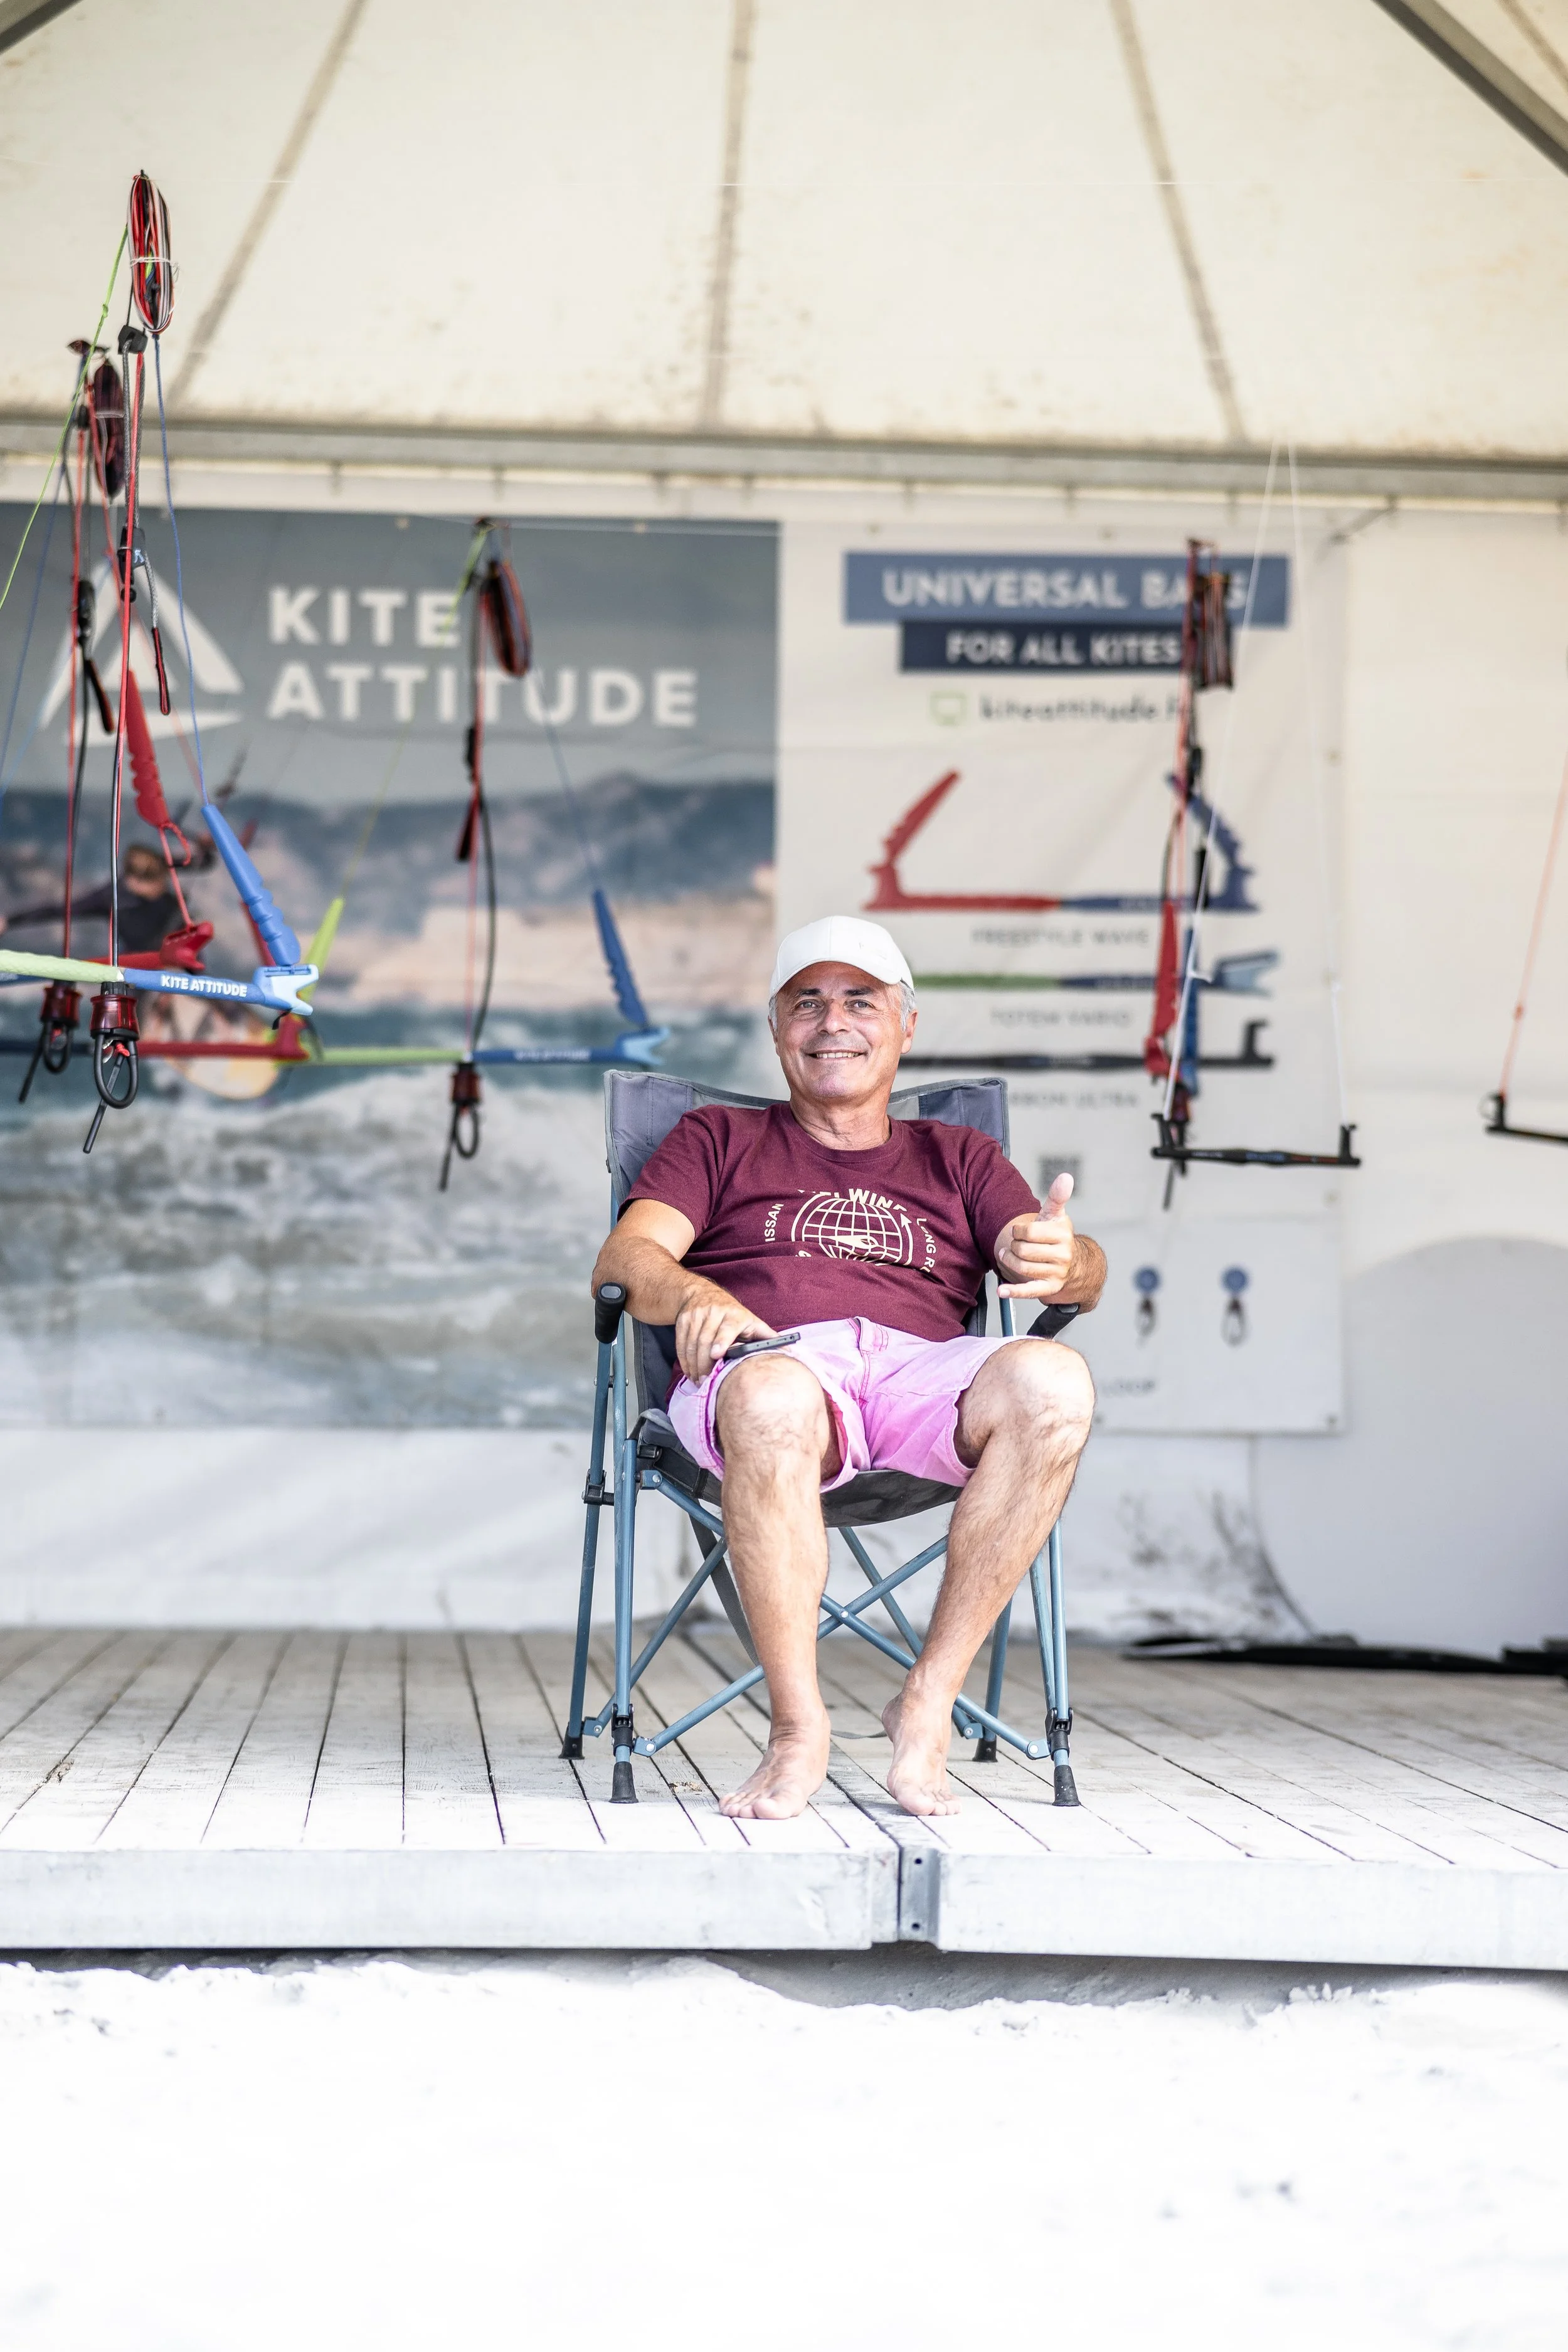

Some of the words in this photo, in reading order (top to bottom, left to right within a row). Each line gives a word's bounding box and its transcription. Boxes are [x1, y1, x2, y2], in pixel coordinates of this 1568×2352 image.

[883, 567, 1128, 610] UNIVERSAL
[1141, 569, 1248, 610] BAS
[269, 586, 462, 647] KITE
[946, 634, 1016, 665] FOR
[1019, 635, 1083, 665] ALL
[1090, 636, 1181, 666] KITES
[267, 660, 699, 728] ATTITUDE
[161, 974, 189, 990] KITE
[189, 978, 248, 998] ATTITUDE
